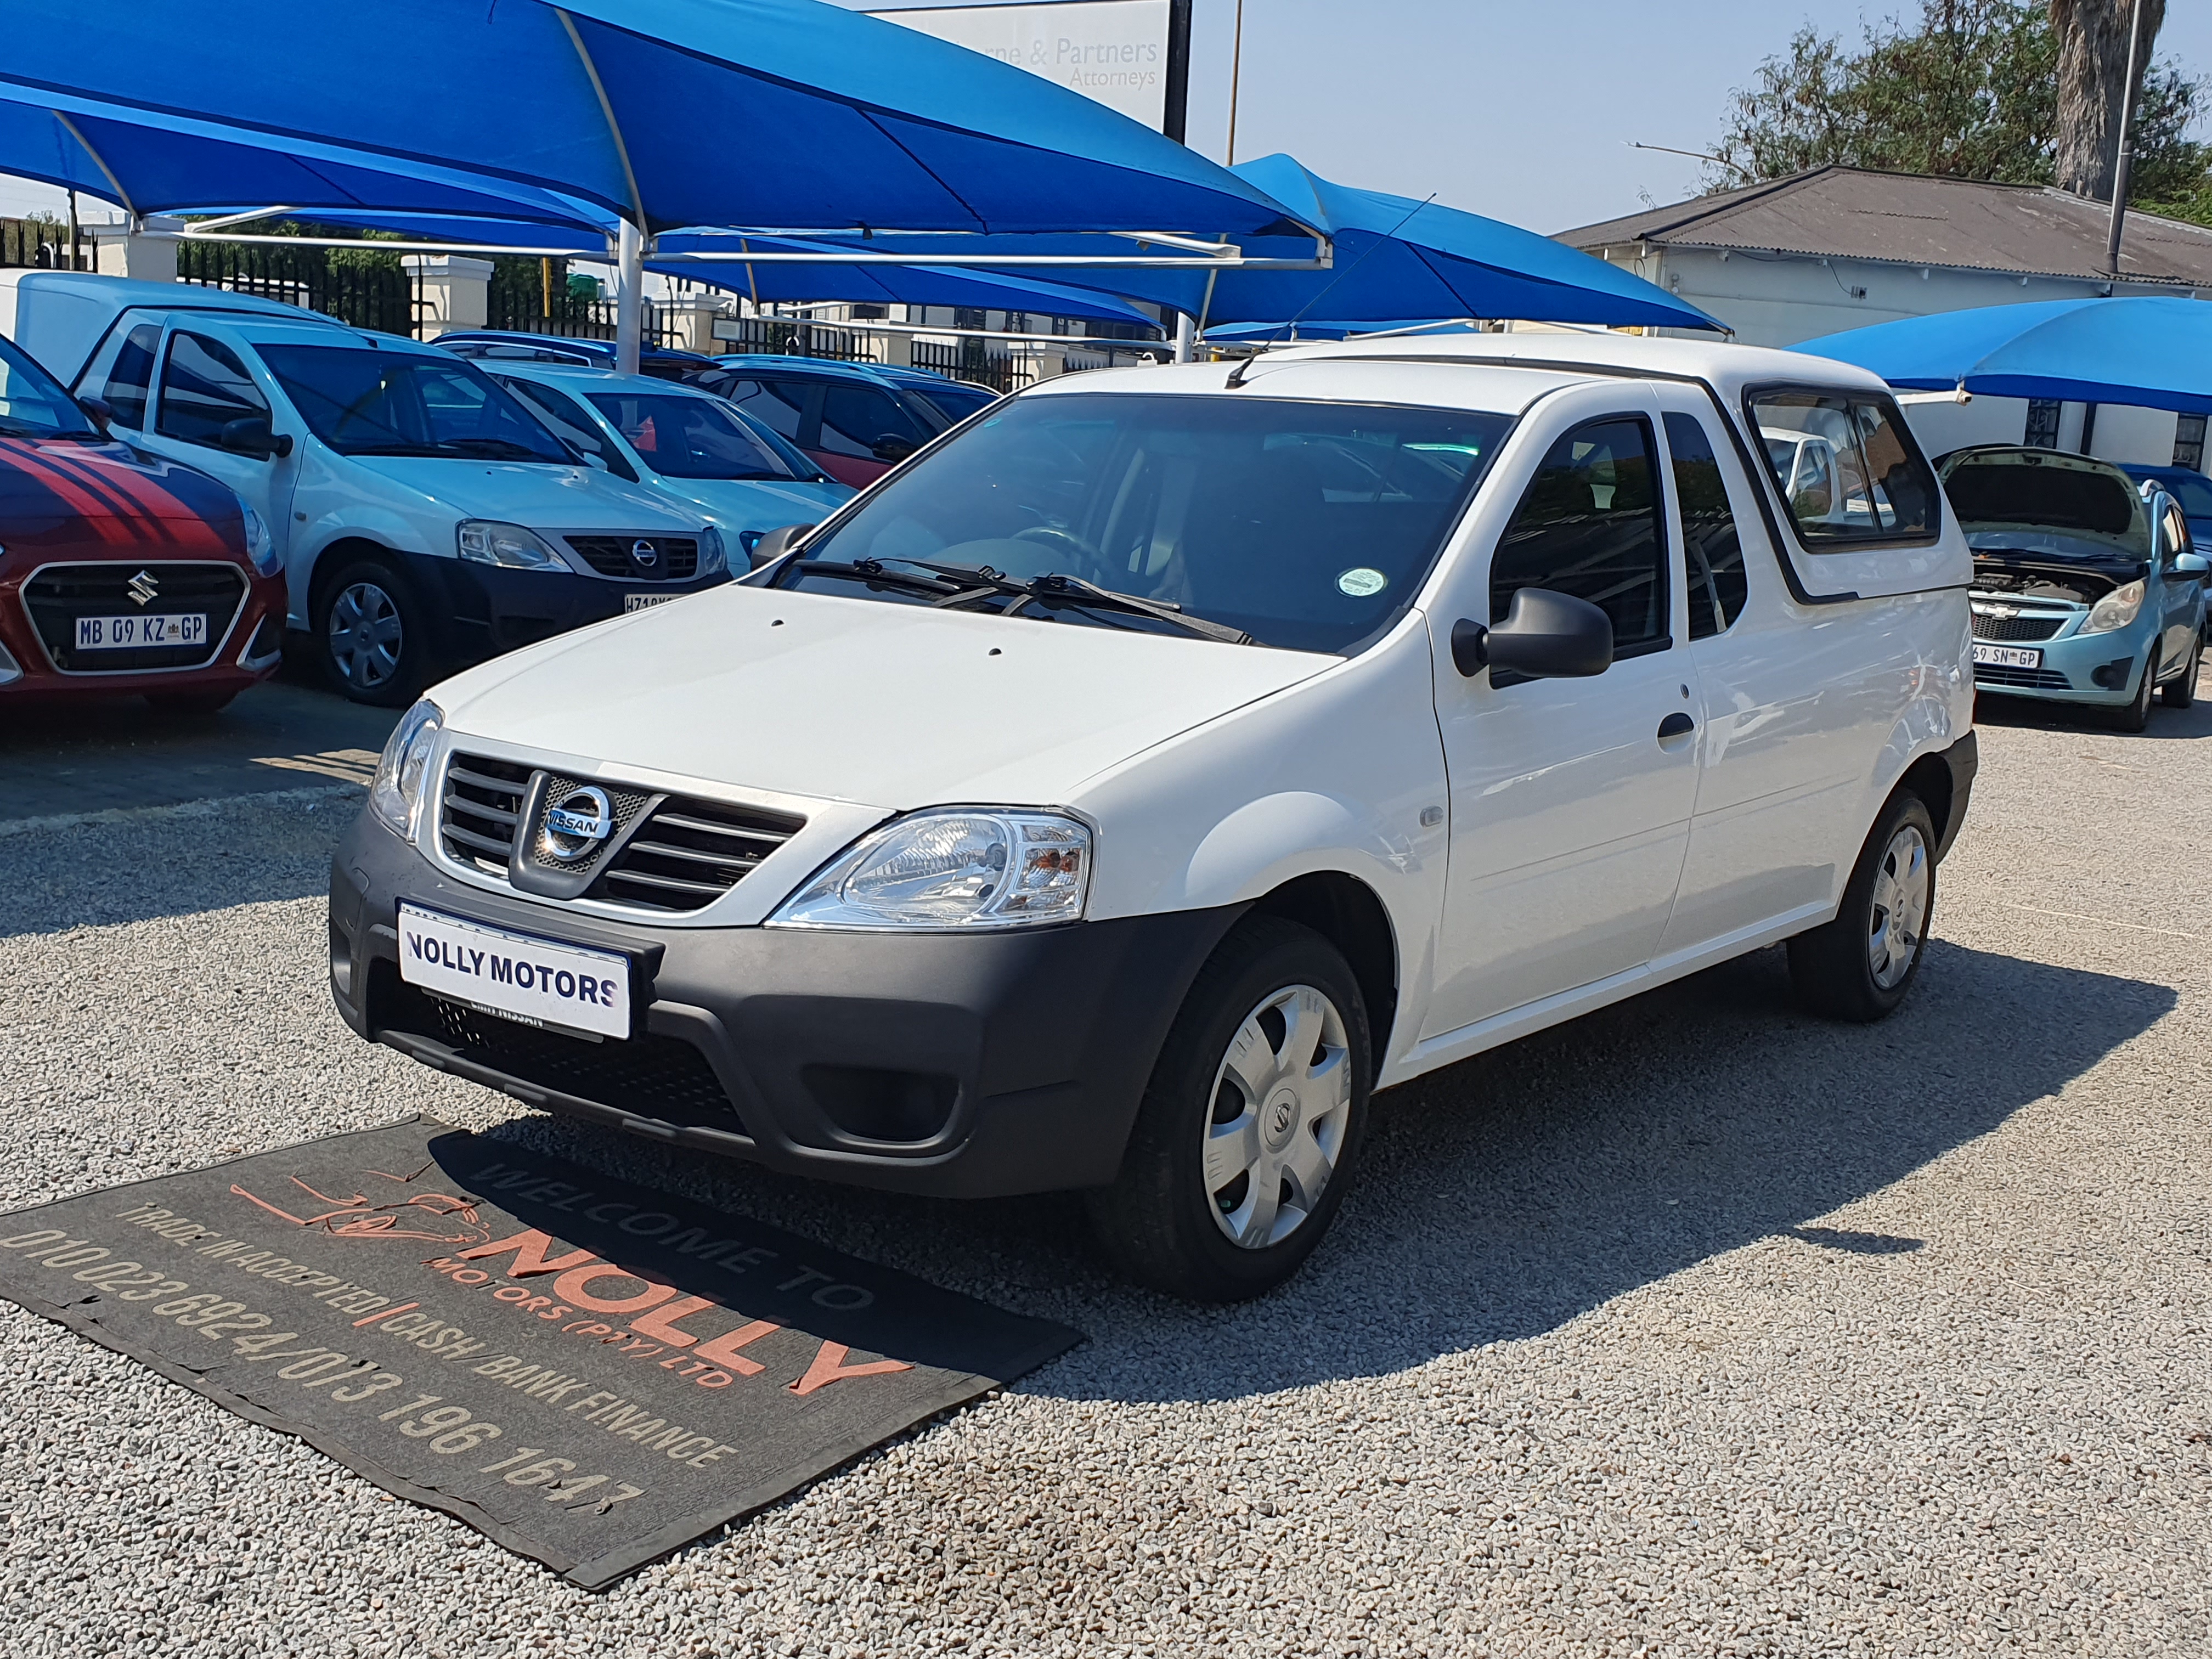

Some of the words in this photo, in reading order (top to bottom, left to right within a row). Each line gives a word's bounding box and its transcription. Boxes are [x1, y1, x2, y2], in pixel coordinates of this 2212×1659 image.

[1030, 40, 1047, 65] &
[1056, 38, 1157, 64] Partners
[1070, 68, 1155, 91] Attorneys
[80, 620, 103, 644] MB
[112, 619, 134, 643] 09
[143, 618, 165, 641] KZ
[181, 616, 202, 641] GP
[1973, 647, 1987, 661] 69
[1993, 649, 2008, 663] SN
[2019, 652, 2035, 665] GP
[549, 813, 599, 834] NISSAN
[407, 931, 486, 977] NOLLY
[490, 954, 618, 1008] MOTORS
[469, 1163, 779, 1273] WELCOME
[776, 1265, 875, 1310] TO
[115, 1201, 222, 1246] TRADE
[195, 1239, 255, 1259] IN
[563, 1390, 740, 1469] FINANCE
[455, 1226, 916, 1395] NOLLY
[0, 1229, 111, 1268] 010
[72, 1261, 189, 1301] 023
[378, 1393, 503, 1454] 196
[477, 1447, 648, 1516] 1647
[561, 1320, 664, 1358] (PTY)
[658, 1356, 733, 1388] LTD
